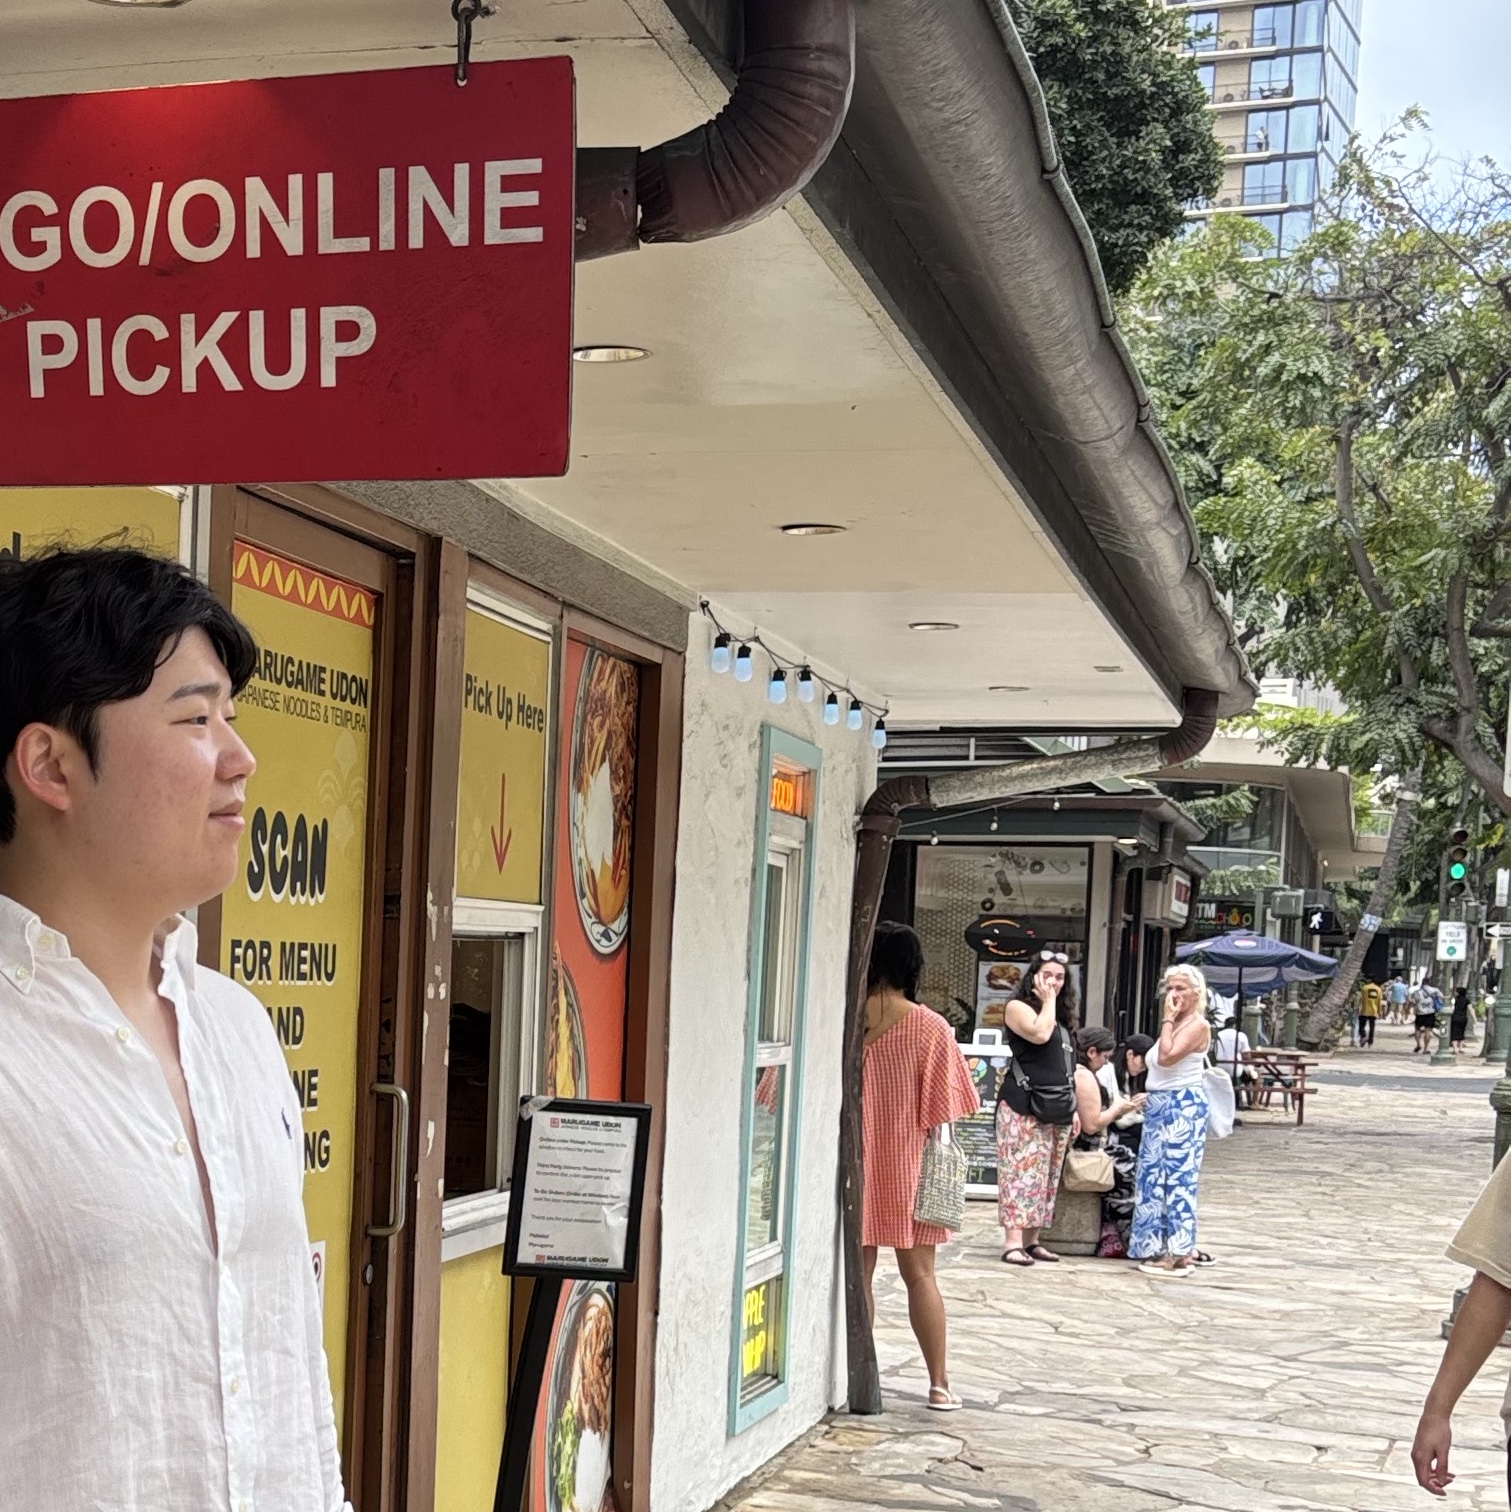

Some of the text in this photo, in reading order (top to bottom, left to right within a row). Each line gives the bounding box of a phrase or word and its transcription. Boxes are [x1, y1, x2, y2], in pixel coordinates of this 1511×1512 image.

[26, 304, 378, 400] PICKUP
[252, 646, 368, 709] ARUGAME UDON
[464, 672, 544, 733] Pick Up Here
[282, 693, 322, 724] NOODLES
[322, 704, 329, 724] &
[329, 705, 368, 733] TEMPURA
[246, 806, 329, 902] SCAN
[229, 939, 337, 985] FOR MENU
[546, 1254, 587, 1262] MARUGAME
